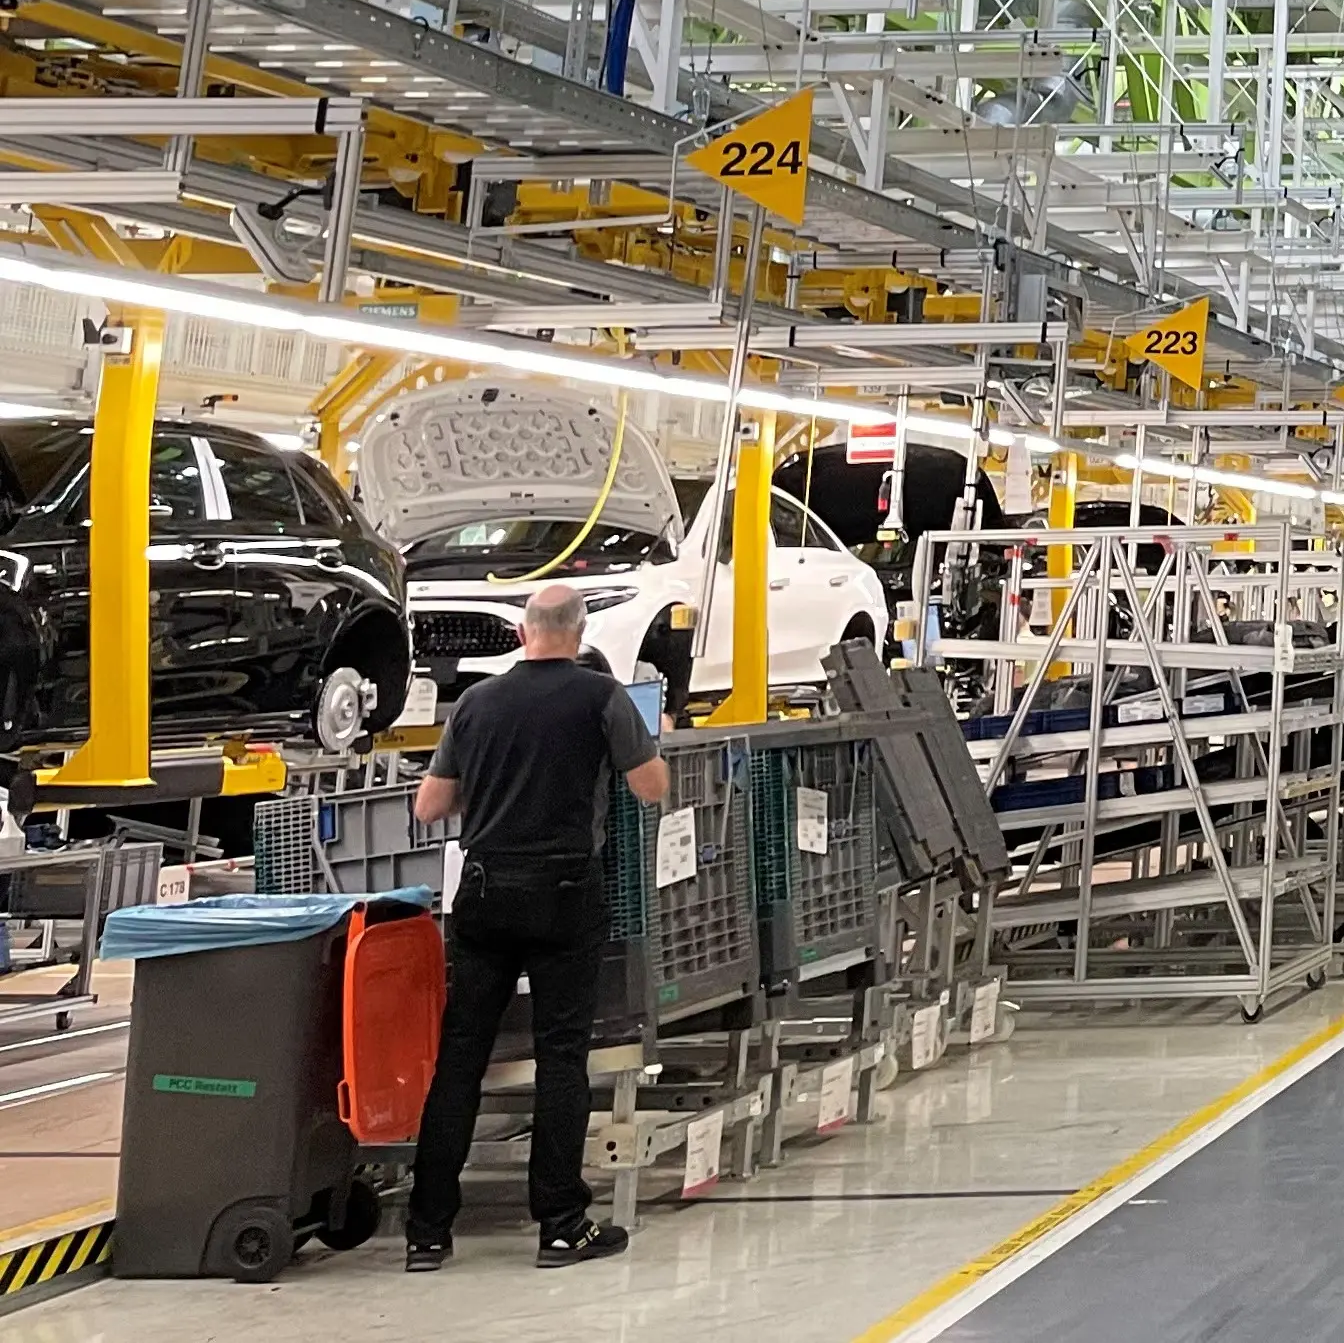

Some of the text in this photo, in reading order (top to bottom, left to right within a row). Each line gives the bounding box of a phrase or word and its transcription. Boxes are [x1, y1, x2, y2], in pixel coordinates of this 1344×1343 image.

[720, 141, 803, 176] 224
[361, 305, 416, 317] SIEMENS
[1144, 330, 1198, 355] 223
